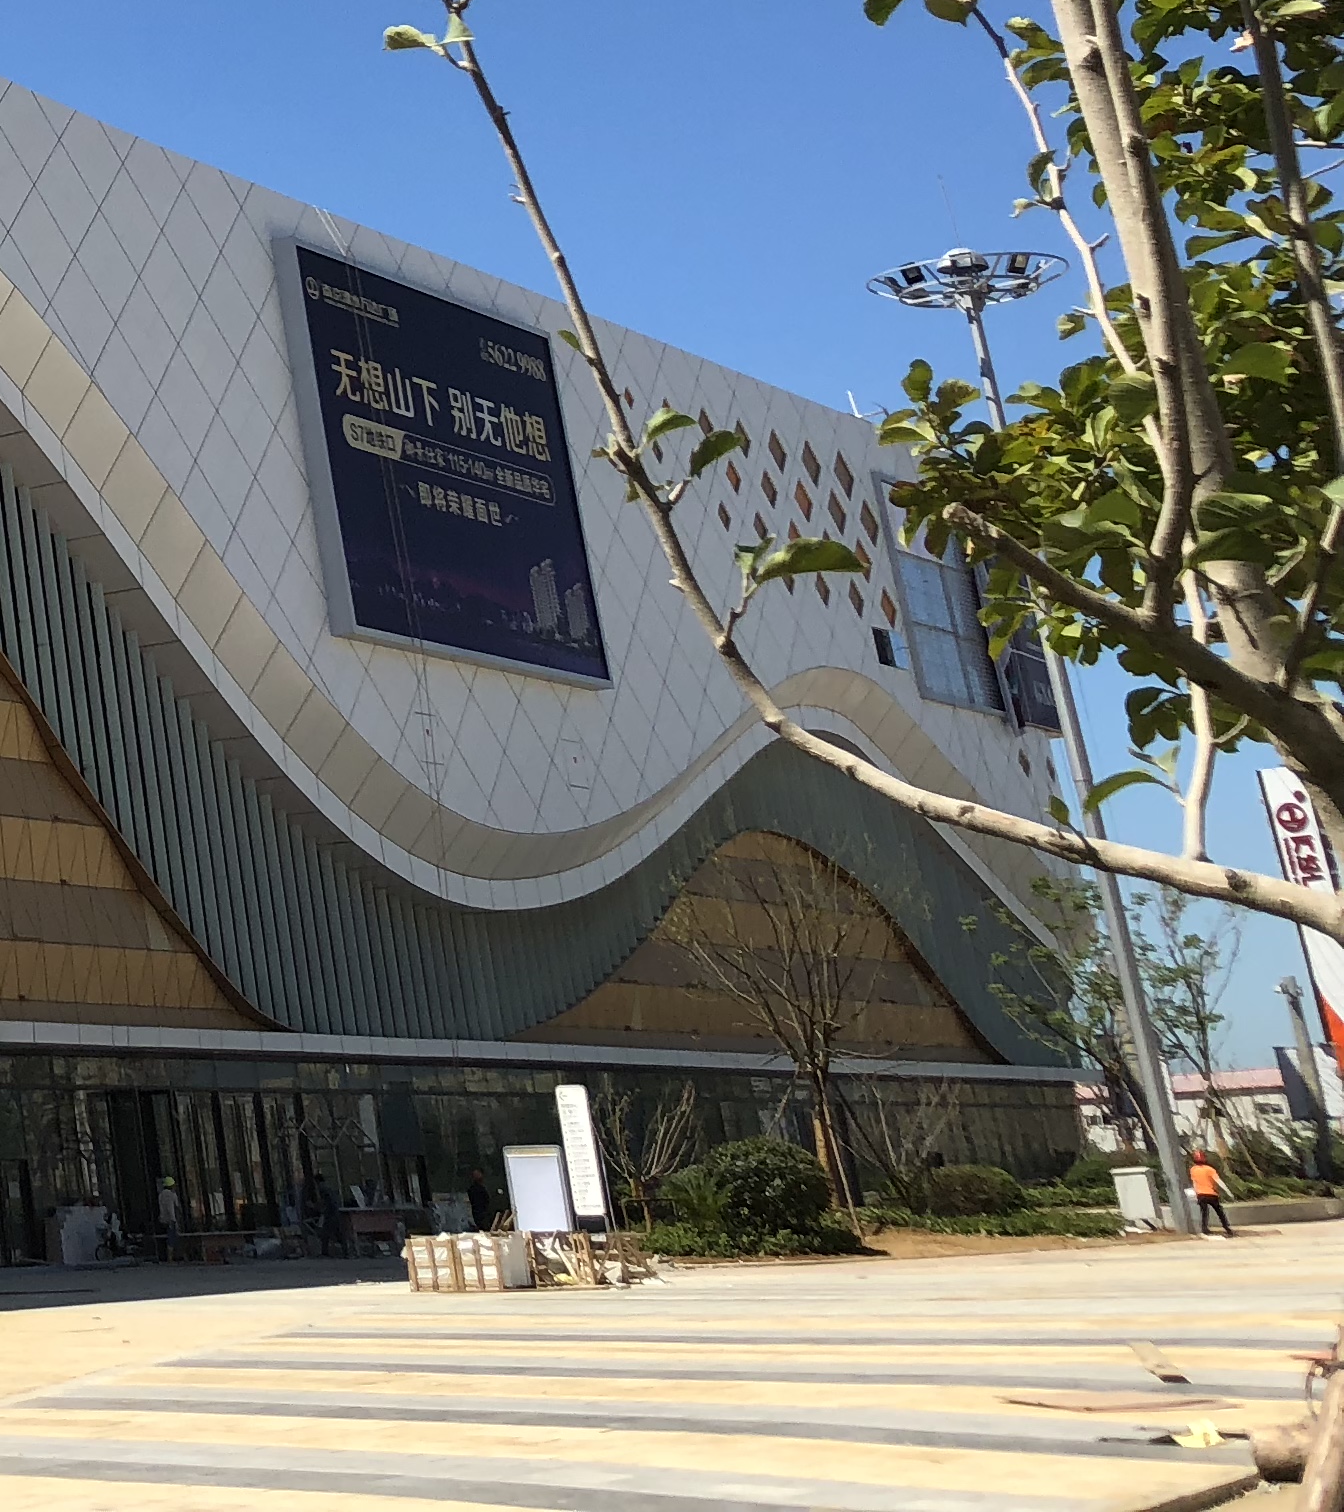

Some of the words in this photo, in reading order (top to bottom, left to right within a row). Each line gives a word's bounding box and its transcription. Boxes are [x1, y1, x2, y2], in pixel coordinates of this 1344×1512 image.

[330, 348, 440, 426] 无想山下
[447, 387, 551, 462] 别无他想
